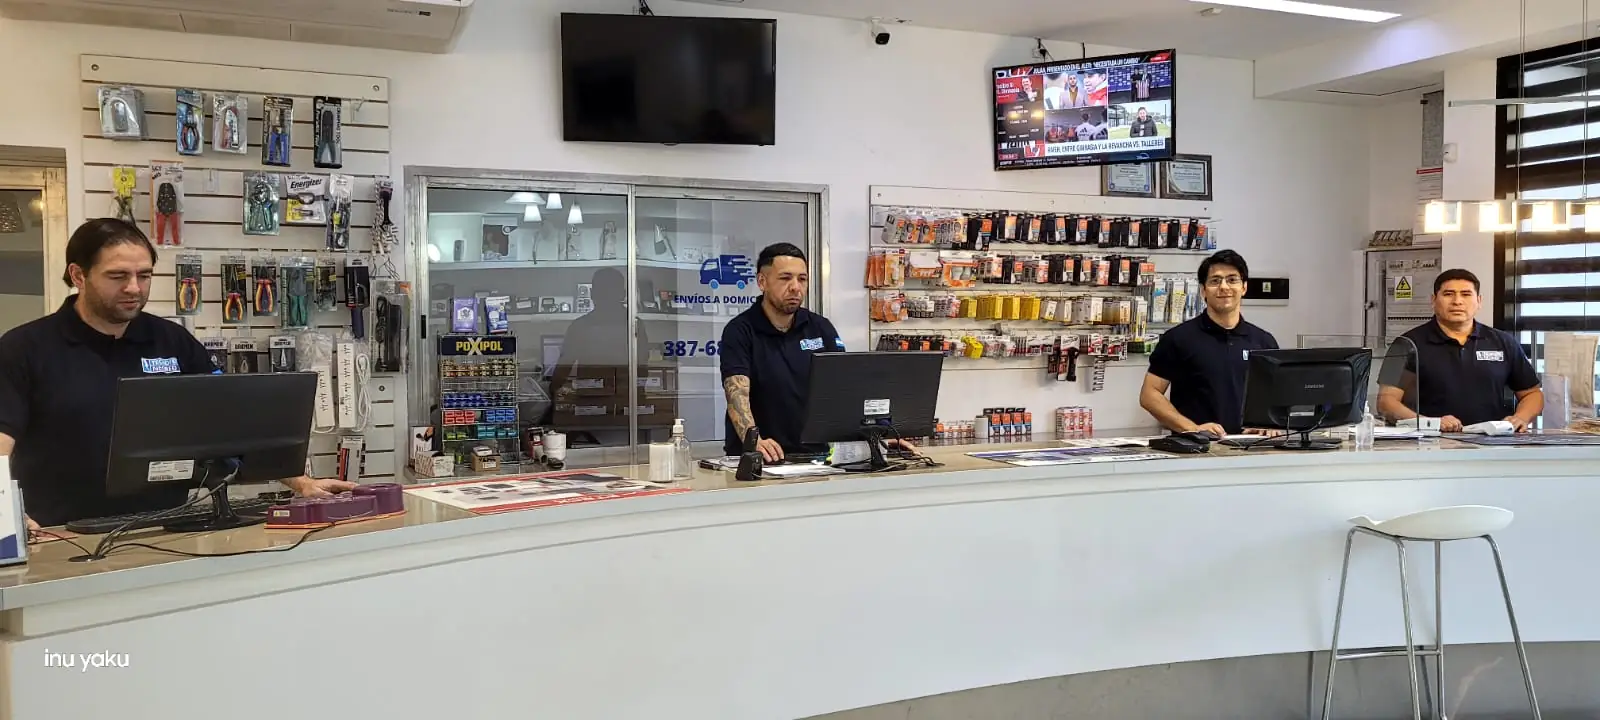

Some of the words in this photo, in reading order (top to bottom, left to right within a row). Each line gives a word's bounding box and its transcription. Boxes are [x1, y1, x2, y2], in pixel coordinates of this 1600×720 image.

[1141, 139, 1164, 148] TALLERES
[290, 178, 323, 190] Energizer
[674, 294, 711, 304] ENVÍOS
[713, 296, 720, 304] A
[456, 338, 503, 356] POXIPOL
